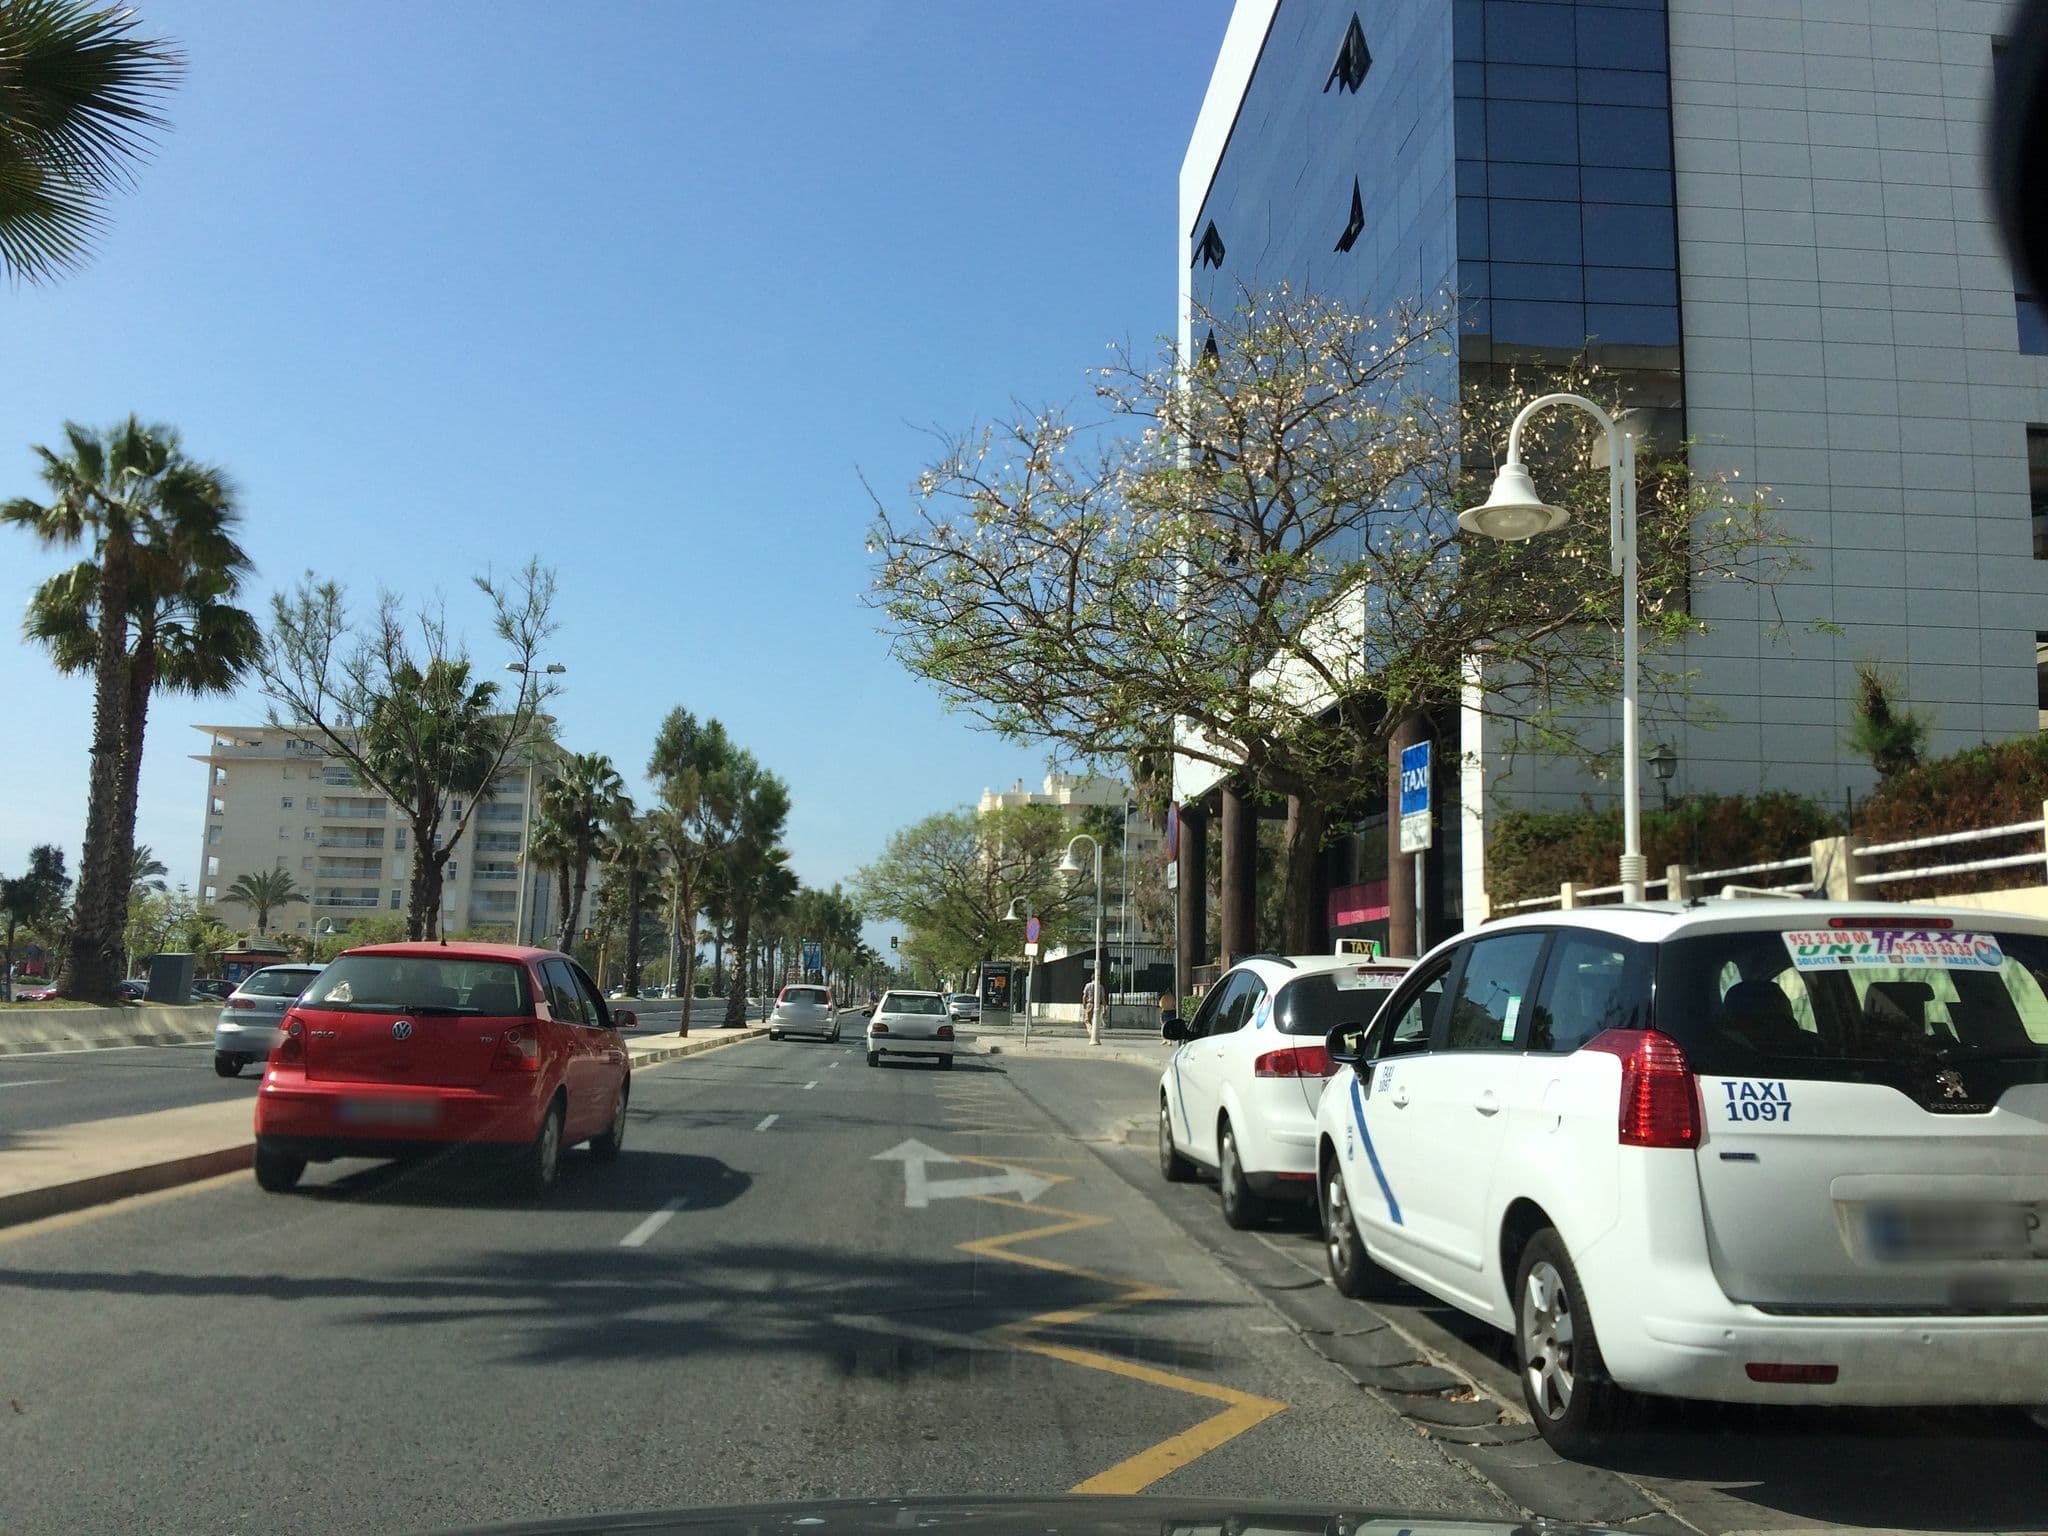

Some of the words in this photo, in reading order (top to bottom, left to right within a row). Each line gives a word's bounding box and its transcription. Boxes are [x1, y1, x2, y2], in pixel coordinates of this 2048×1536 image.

[1402, 766, 1428, 792] TAXI
[1789, 933, 1813, 945] 952
[1816, 932, 1831, 944] 32
[1834, 931, 1850, 943] 00
[1852, 931, 1869, 943] 00
[1350, 942, 1373, 953] TAXI
[1895, 942, 1918, 954] 952
[1921, 943, 1937, 955] 33
[1939, 943, 1955, 955] 33
[1957, 944, 1972, 956] 33
[1721, 1082, 1787, 1101] TAXI
[1726, 1101, 1791, 1121] 1097
